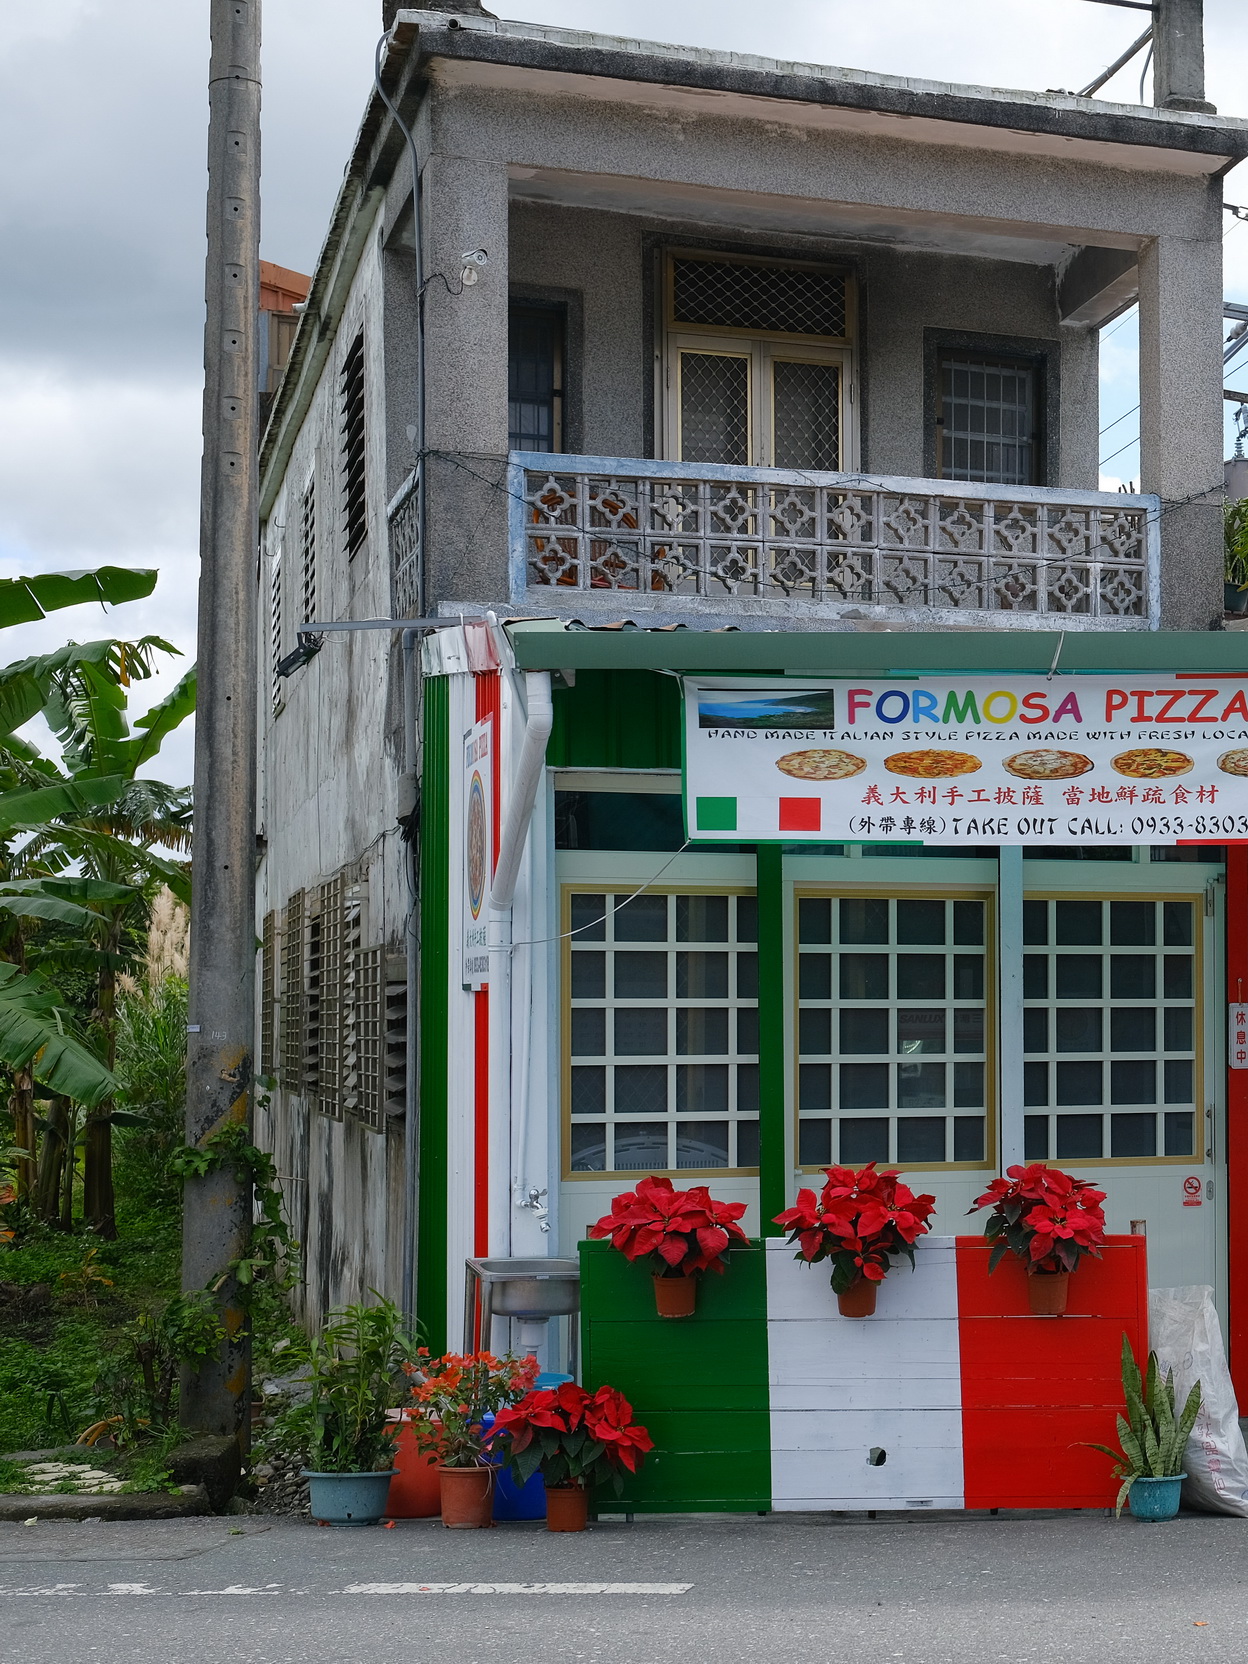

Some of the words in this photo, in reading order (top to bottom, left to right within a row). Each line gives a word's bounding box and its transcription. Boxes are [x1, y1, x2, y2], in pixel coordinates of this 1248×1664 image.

[847, 689, 1082, 725] FORMOSA
[708, 729, 758, 740] HAND
[765, 731, 815, 741] MADE
[823, 731, 894, 742] ITALIAN
[902, 731, 958, 741] STYLE
[965, 731, 1019, 742] PIZZA
[1027, 731, 1079, 741] MADE
[1086, 730, 1132, 740] WITH
[1138, 730, 1196, 740] FRESH
[860, 785, 1045, 806] 義大利手工披薩
[1062, 784, 1219, 806] 當地鮮疏食材
[951, 816, 1009, 836] TAKE
[1018, 816, 1058, 836] OUT
[1067, 815, 1124, 836] CALL:
[899, 1014, 945, 1024] SANLUX
[1235, 1011, 1246, 1064] 休息中
